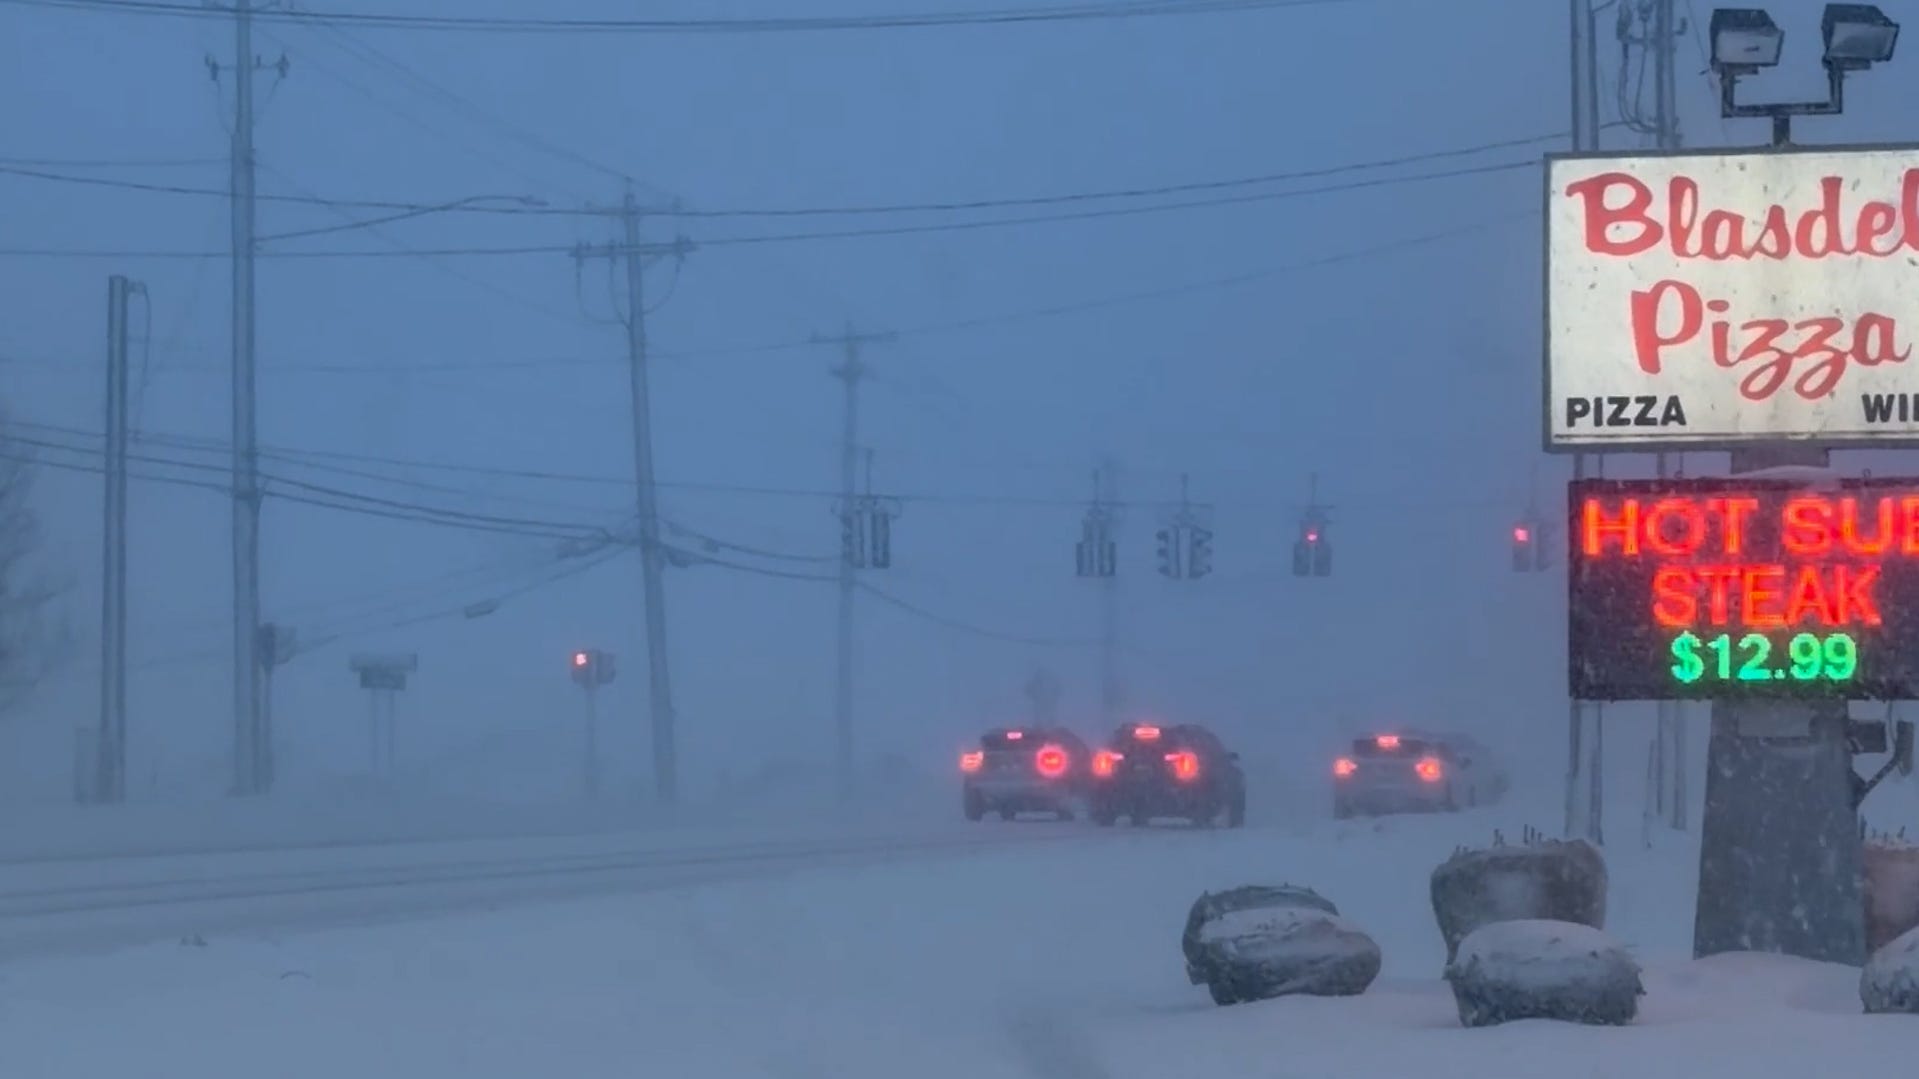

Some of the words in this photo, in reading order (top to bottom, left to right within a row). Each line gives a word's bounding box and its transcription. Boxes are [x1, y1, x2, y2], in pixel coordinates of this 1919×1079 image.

[1630, 279, 1912, 401] Pizza
[1565, 395, 1687, 427] PIZZA
[1861, 393, 1919, 423] WI
[1582, 497, 1759, 555] HOT
[1652, 564, 1882, 627] STEAK
[1670, 630, 1857, 683] $12.99
